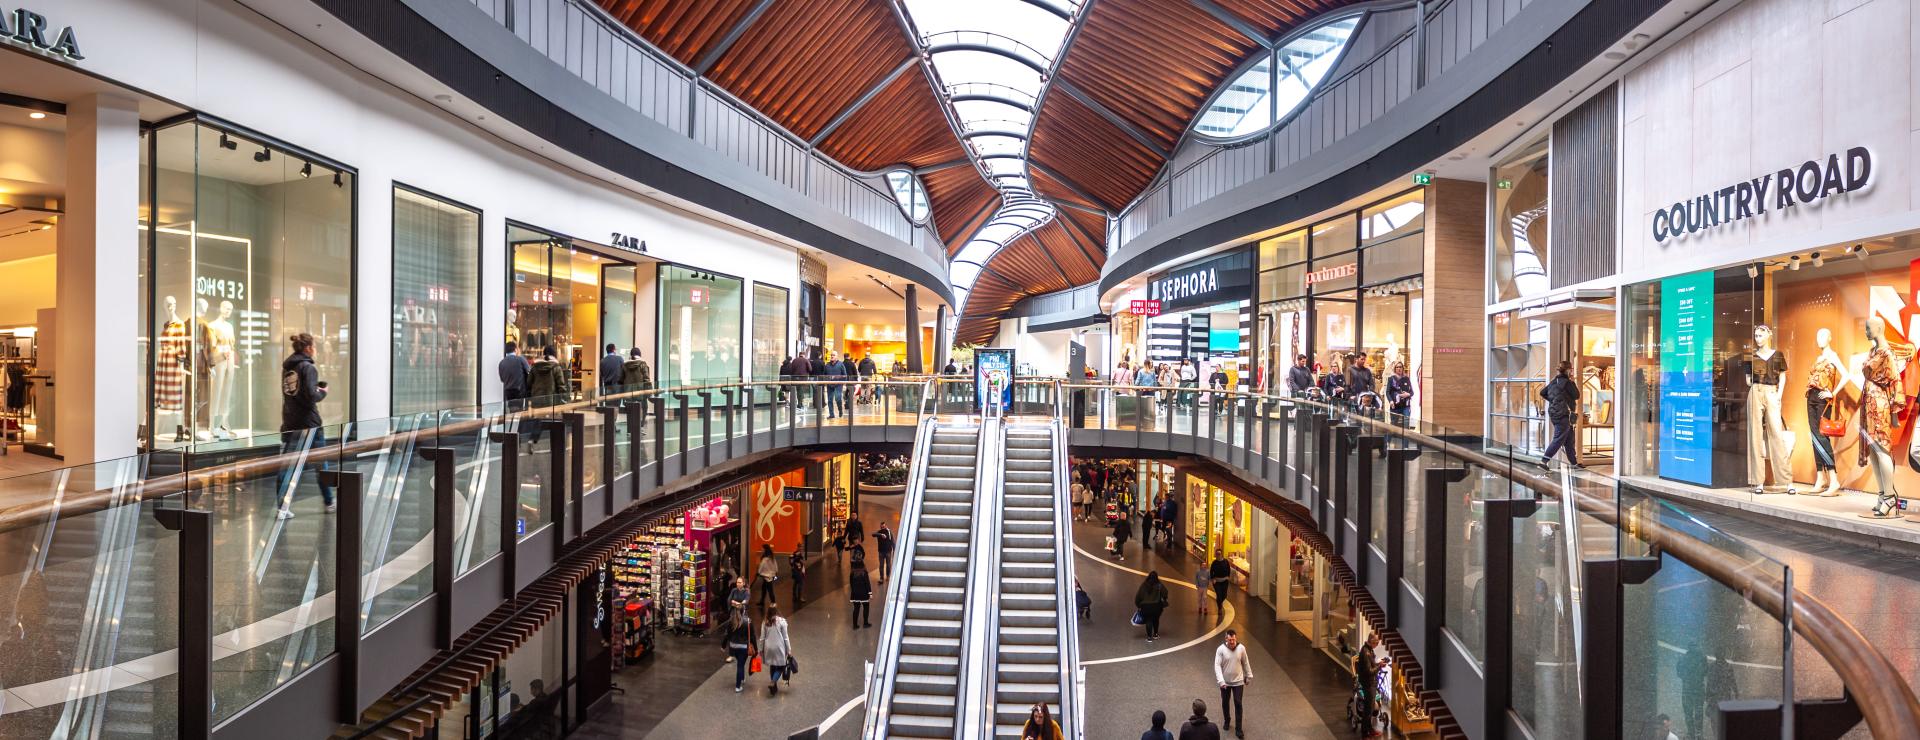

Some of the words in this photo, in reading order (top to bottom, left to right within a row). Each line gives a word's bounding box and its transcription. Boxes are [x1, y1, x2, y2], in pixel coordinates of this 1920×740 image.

[1653, 174, 1771, 242] COUNTRY
[1777, 146, 1872, 210] ROAD
[611, 232, 648, 252] ZARA
[1162, 267, 1218, 302] SEPHORA
[1071, 347, 1077, 356] 3
